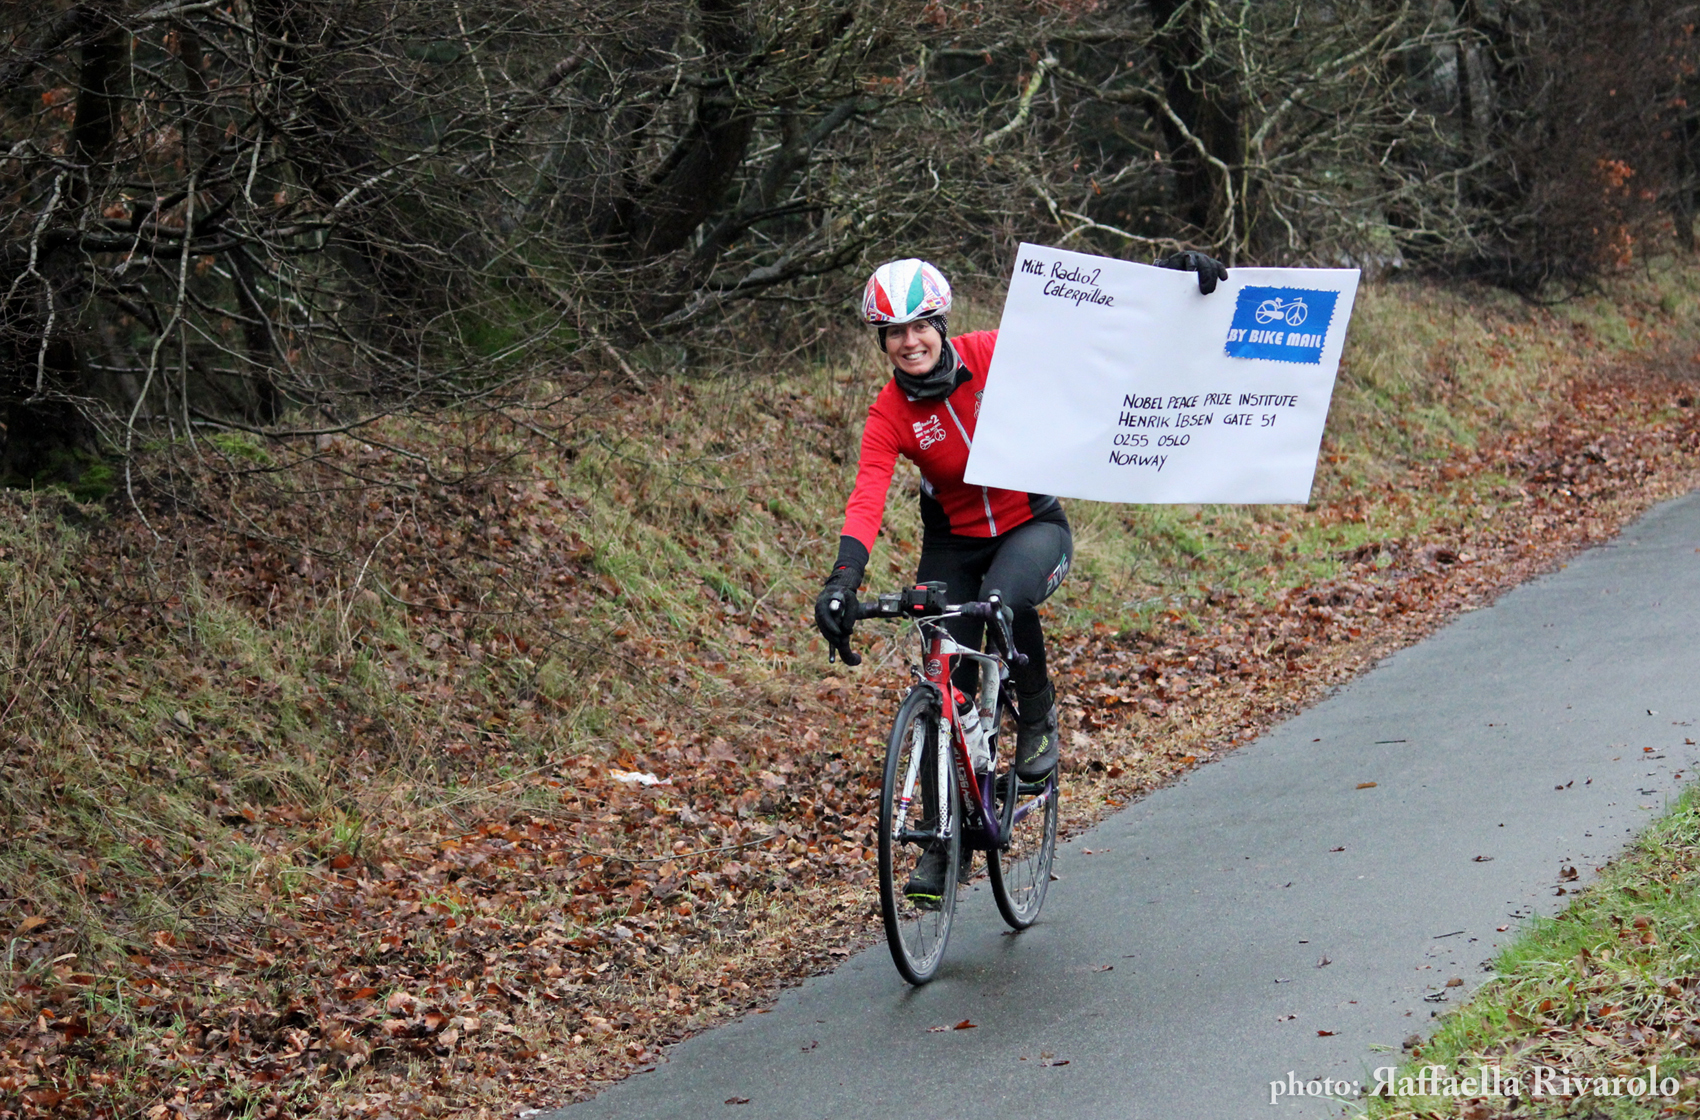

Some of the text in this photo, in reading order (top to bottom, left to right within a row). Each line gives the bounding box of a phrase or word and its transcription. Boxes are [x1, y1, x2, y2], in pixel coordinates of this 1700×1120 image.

[1227, 328, 1322, 348] BY BIKE MAIL
[1122, 392, 1299, 410] NOBEL PEACE PRIZE INSTITUTE
[1118, 410, 1277, 428] HENRIK IBSEN GATE 51
[1113, 433, 1191, 448] 0255 OSLO
[1108, 450, 1169, 472] NORWAY
